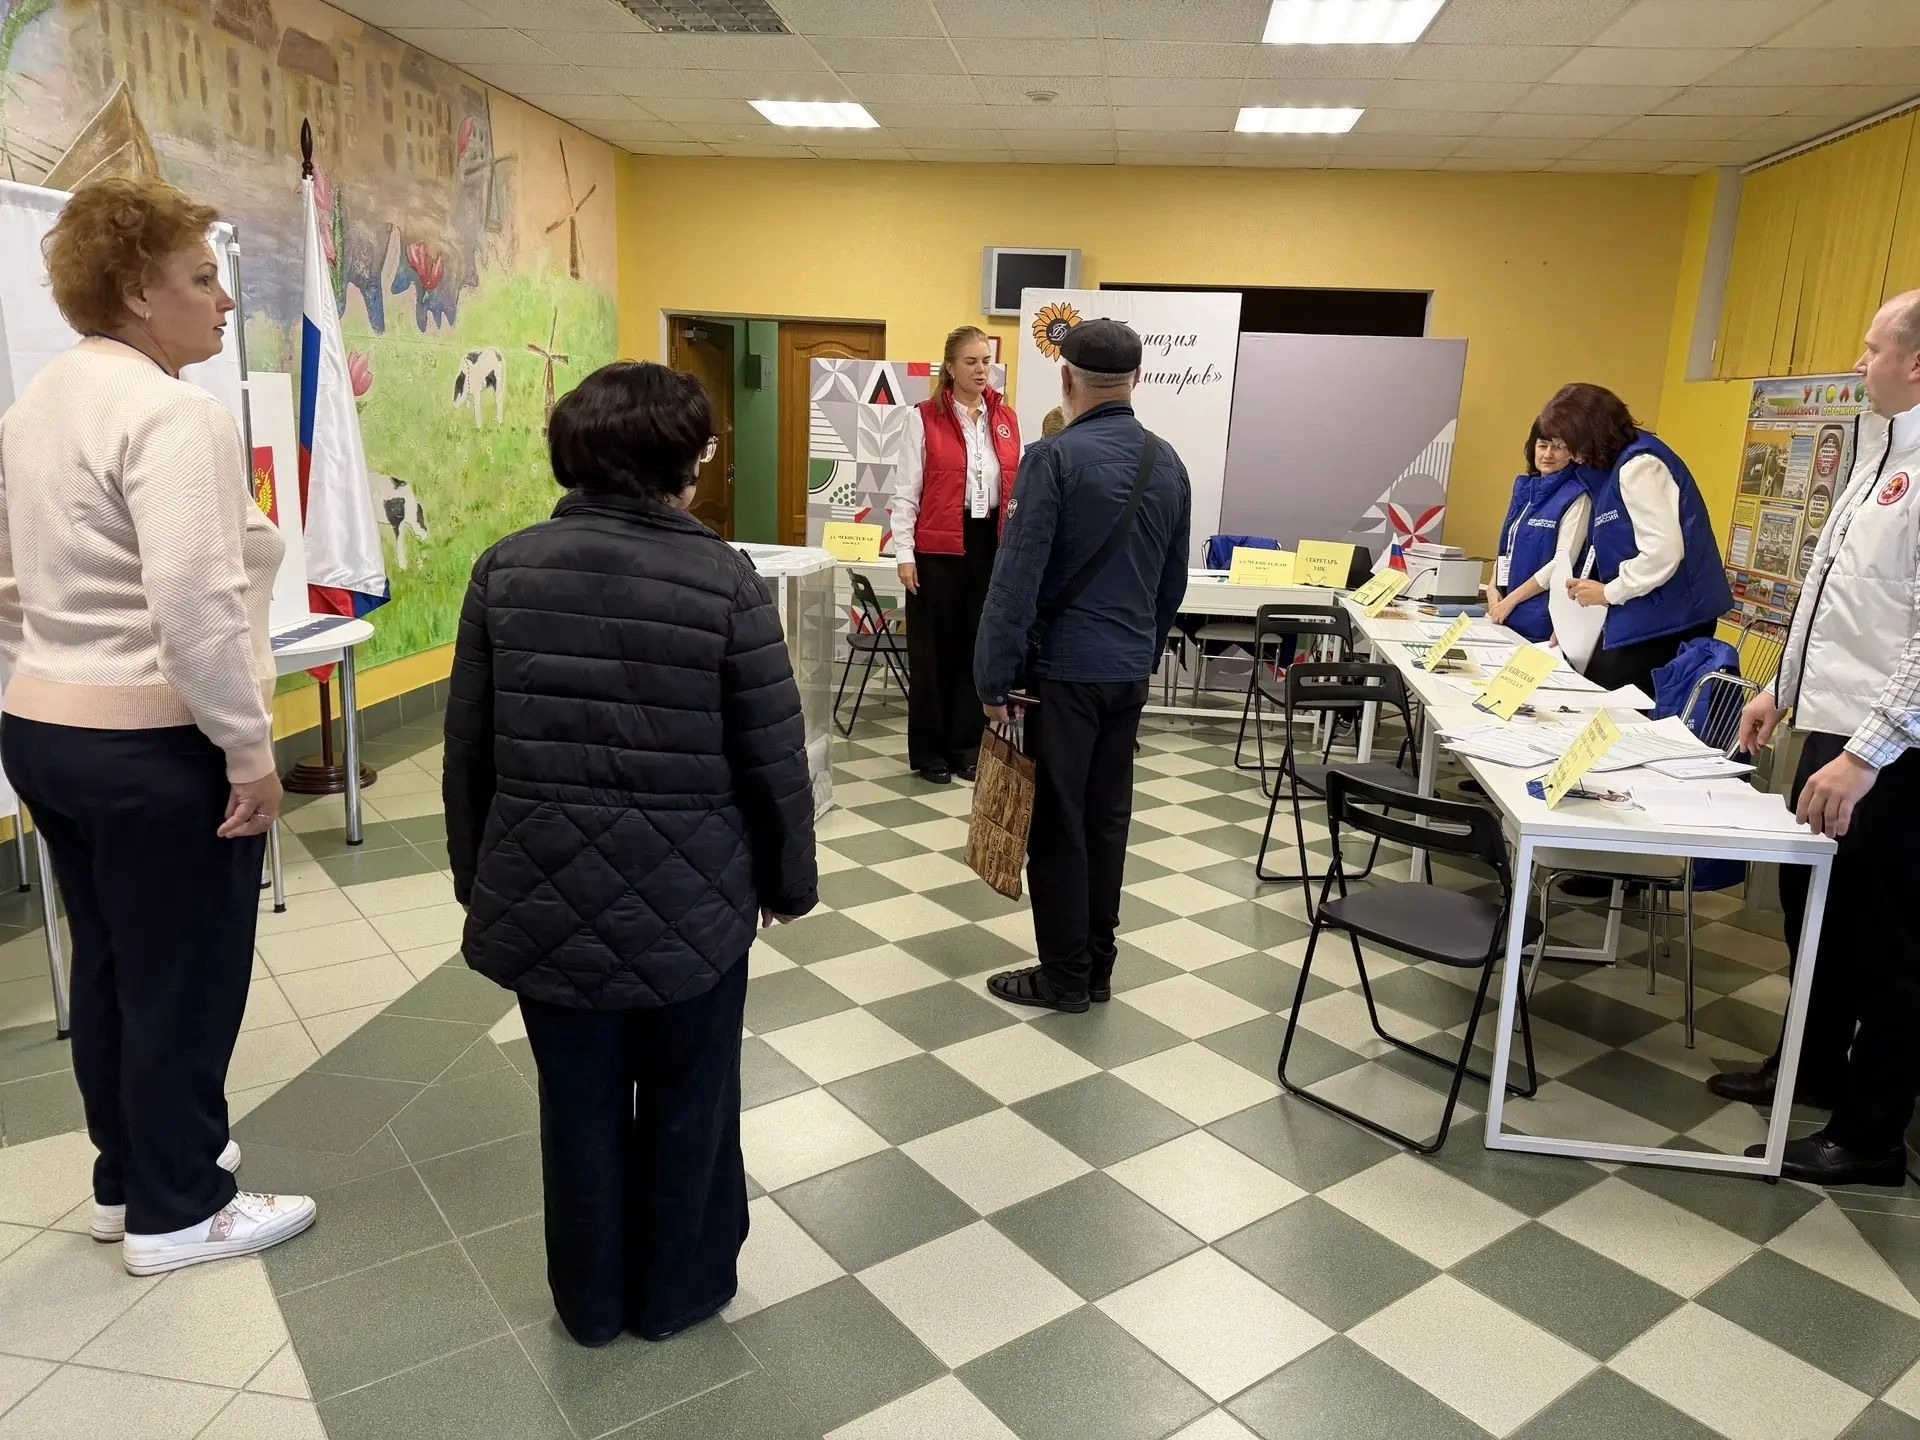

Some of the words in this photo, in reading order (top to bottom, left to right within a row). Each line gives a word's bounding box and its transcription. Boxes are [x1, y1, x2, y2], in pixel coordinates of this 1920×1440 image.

[1138, 333, 1198, 357] назия
[1137, 363, 1223, 395] митров»
[1305, 557, 1338, 565] СЕКРЕТАРЬ
